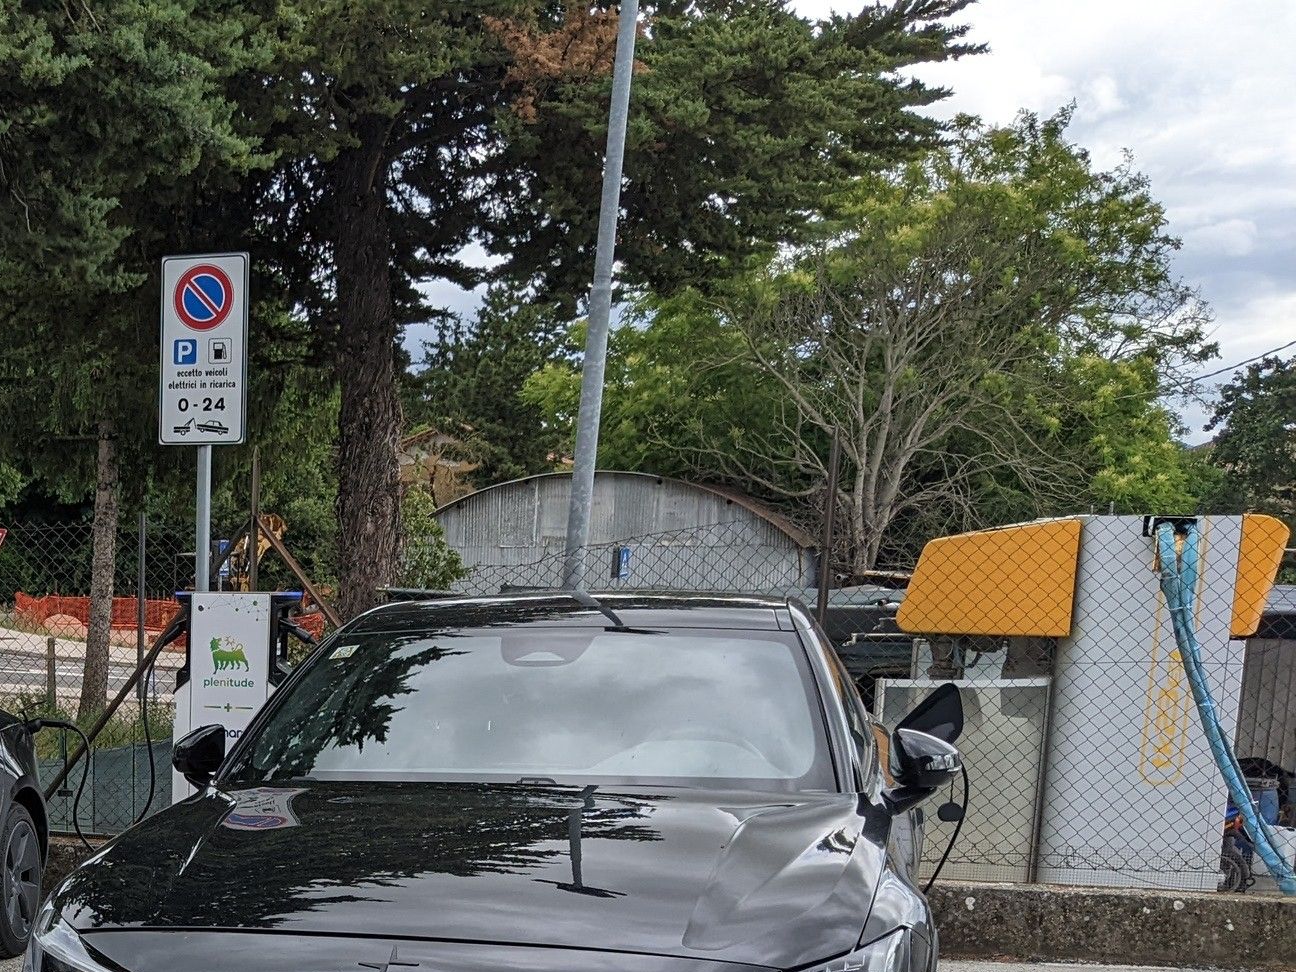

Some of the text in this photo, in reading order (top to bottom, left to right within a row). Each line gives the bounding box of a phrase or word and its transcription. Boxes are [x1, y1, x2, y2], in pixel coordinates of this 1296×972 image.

[178, 341, 193, 363] P
[177, 368, 227, 377] eccetto veicoli
[168, 380, 236, 389] elettrici in ricarica
[203, 677, 255, 688] plenitude
